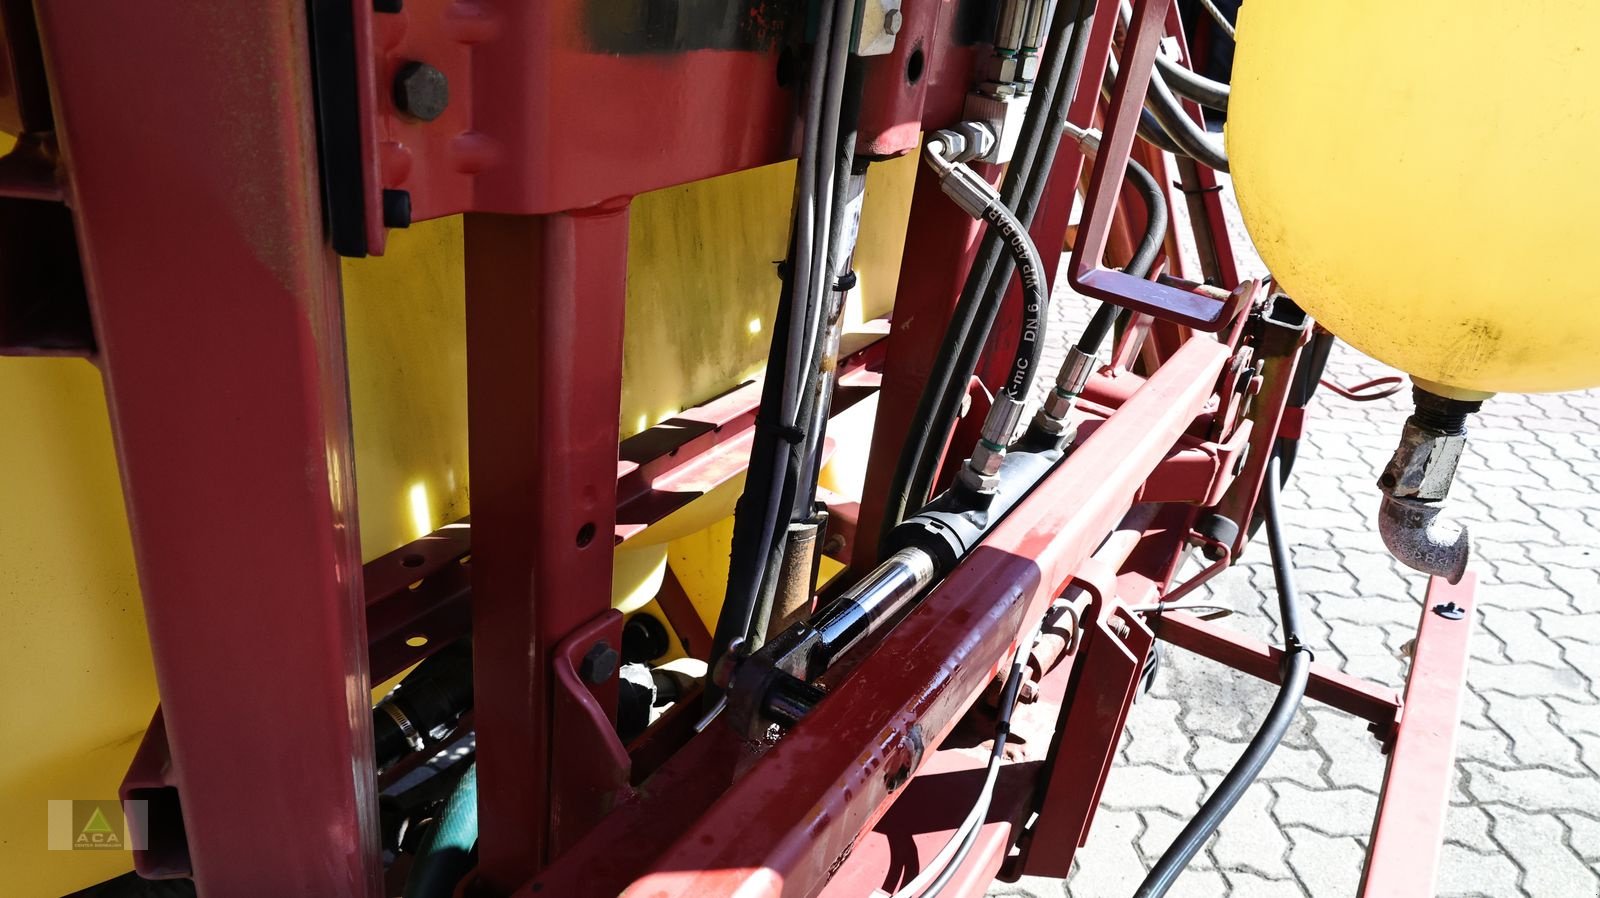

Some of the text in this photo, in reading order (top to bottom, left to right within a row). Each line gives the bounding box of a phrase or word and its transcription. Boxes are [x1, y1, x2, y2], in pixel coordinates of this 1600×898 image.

[988, 207, 1014, 237] BAR
[1011, 236, 1028, 260] 450
[1023, 264, 1039, 289] WP
[1028, 303, 1039, 312] 6
[1024, 318, 1039, 342] DN
